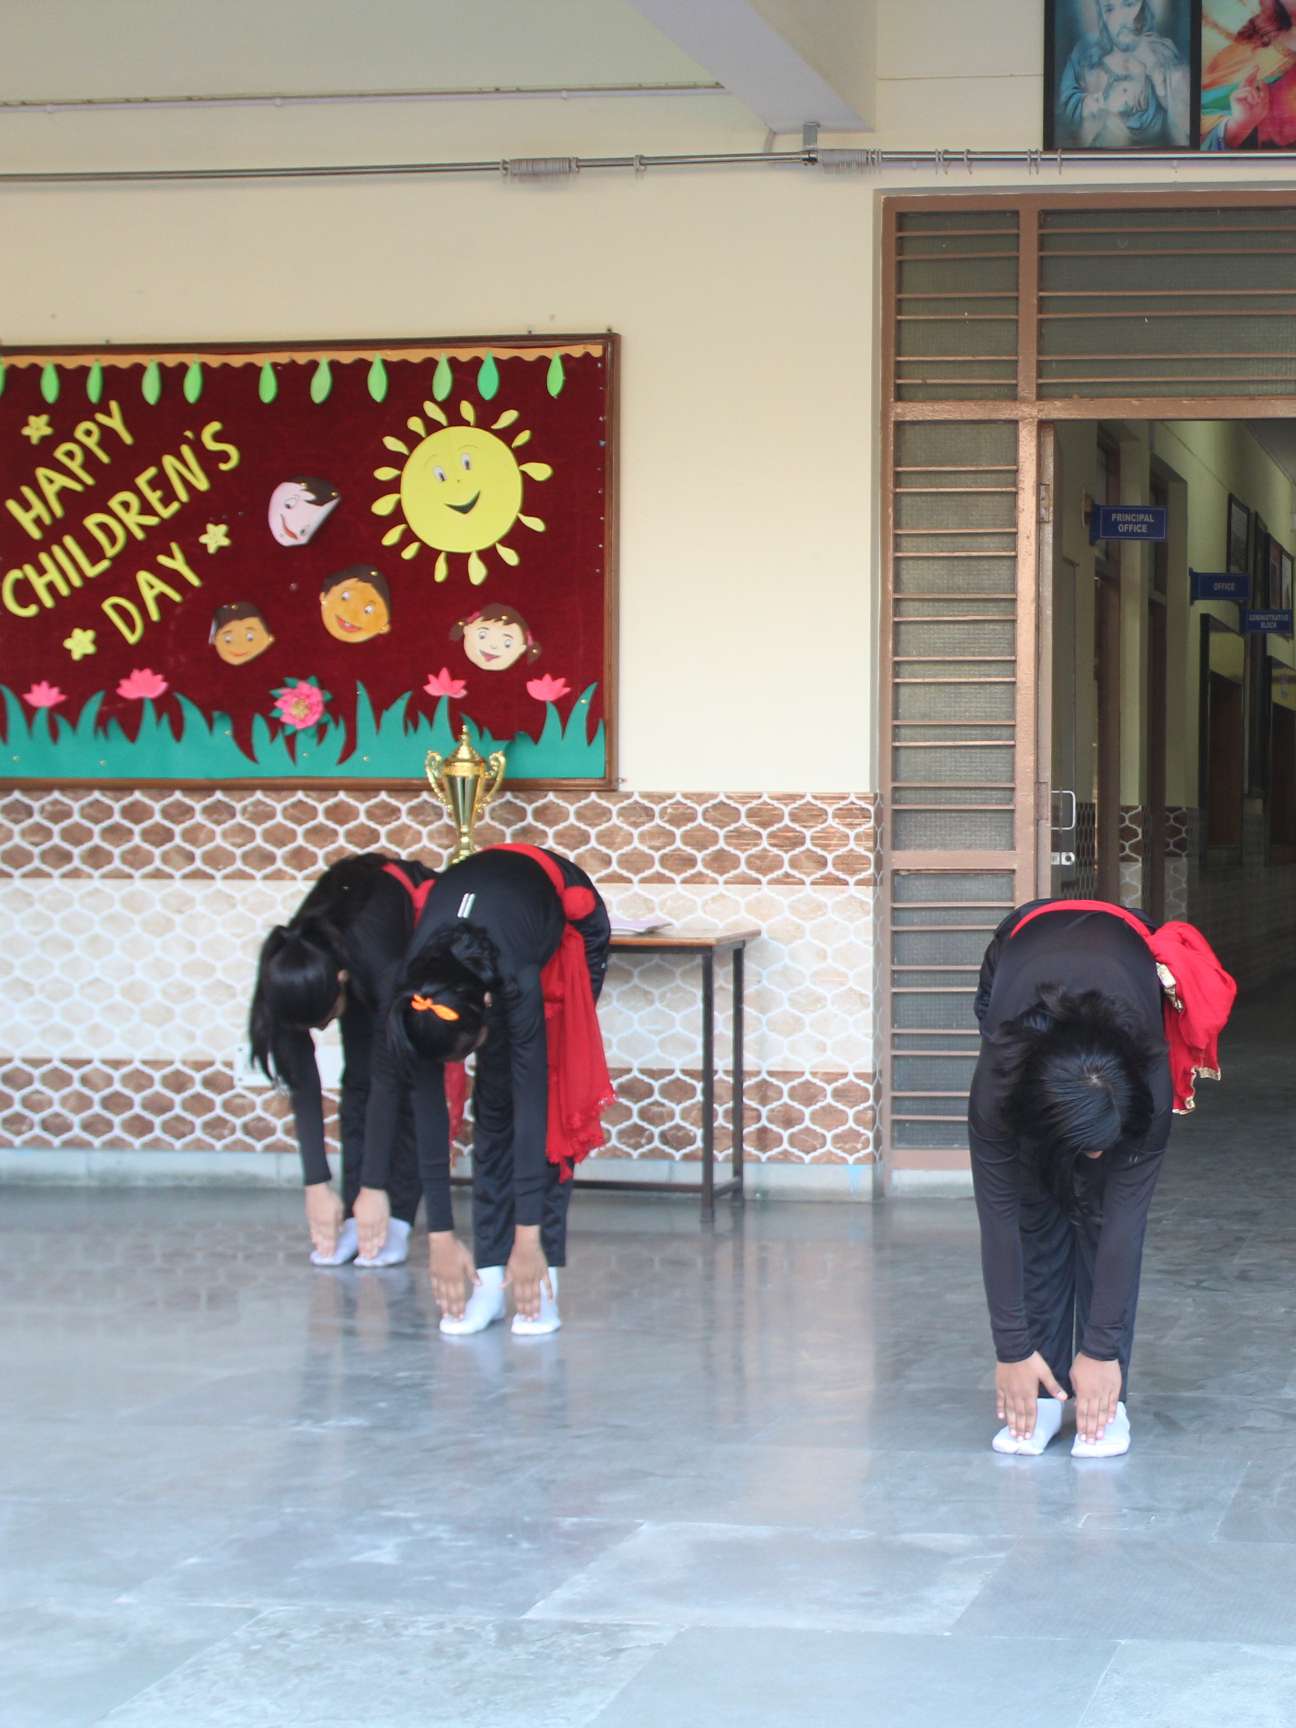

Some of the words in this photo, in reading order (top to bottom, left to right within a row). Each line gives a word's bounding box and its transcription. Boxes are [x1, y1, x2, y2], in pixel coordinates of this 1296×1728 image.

[5, 400, 134, 540] HAPPY
[2, 421, 241, 617] CHILDREN'S
[1111, 513, 1154, 522] PRINCIPAL
[1118, 524, 1147, 533] OFFICE
[101, 542, 202, 645] DAY
[1213, 582, 1235, 591] OFFICE
